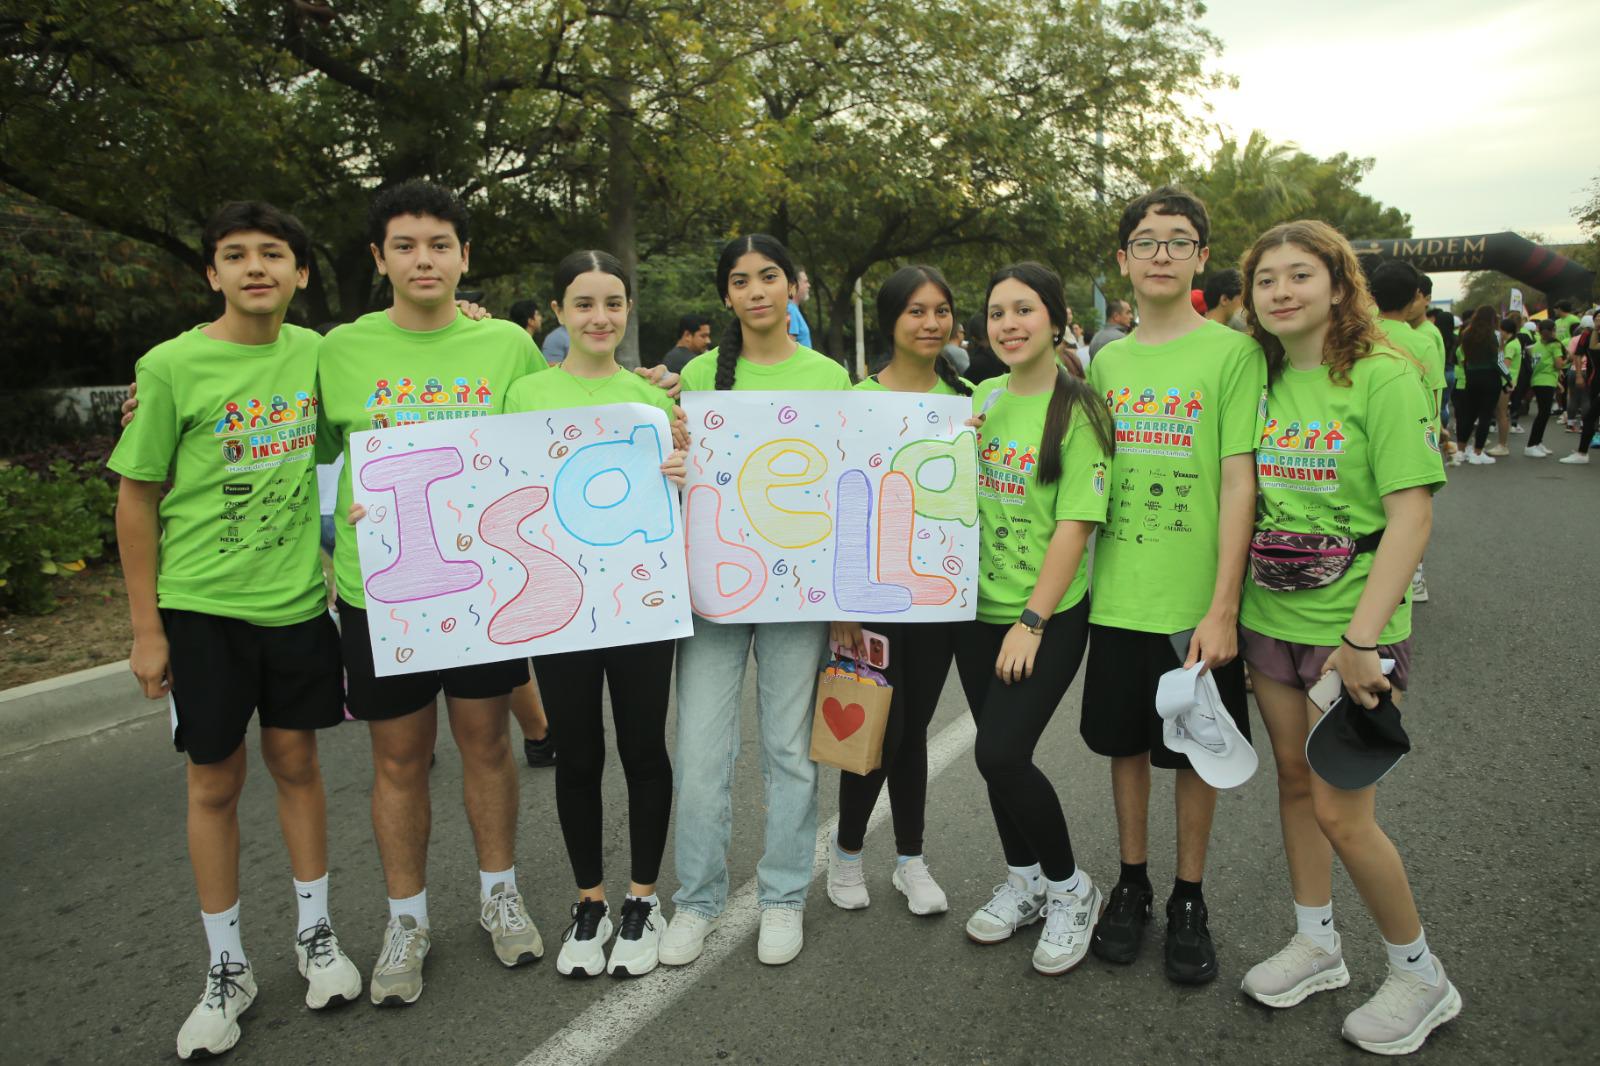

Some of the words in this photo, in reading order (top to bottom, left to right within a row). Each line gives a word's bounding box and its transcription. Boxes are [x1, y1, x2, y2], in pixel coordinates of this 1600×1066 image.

[1392, 237, 1487, 256] IMDEM
[277, 423, 317, 441] CARRER
[1136, 421, 1194, 435] CARRERA
[251, 432, 317, 459] INCLUSIV
[1115, 429, 1192, 447] NCLUSIVA
[1279, 455, 1337, 468] CARRERA
[979, 473, 1025, 496] CLUSIVA
